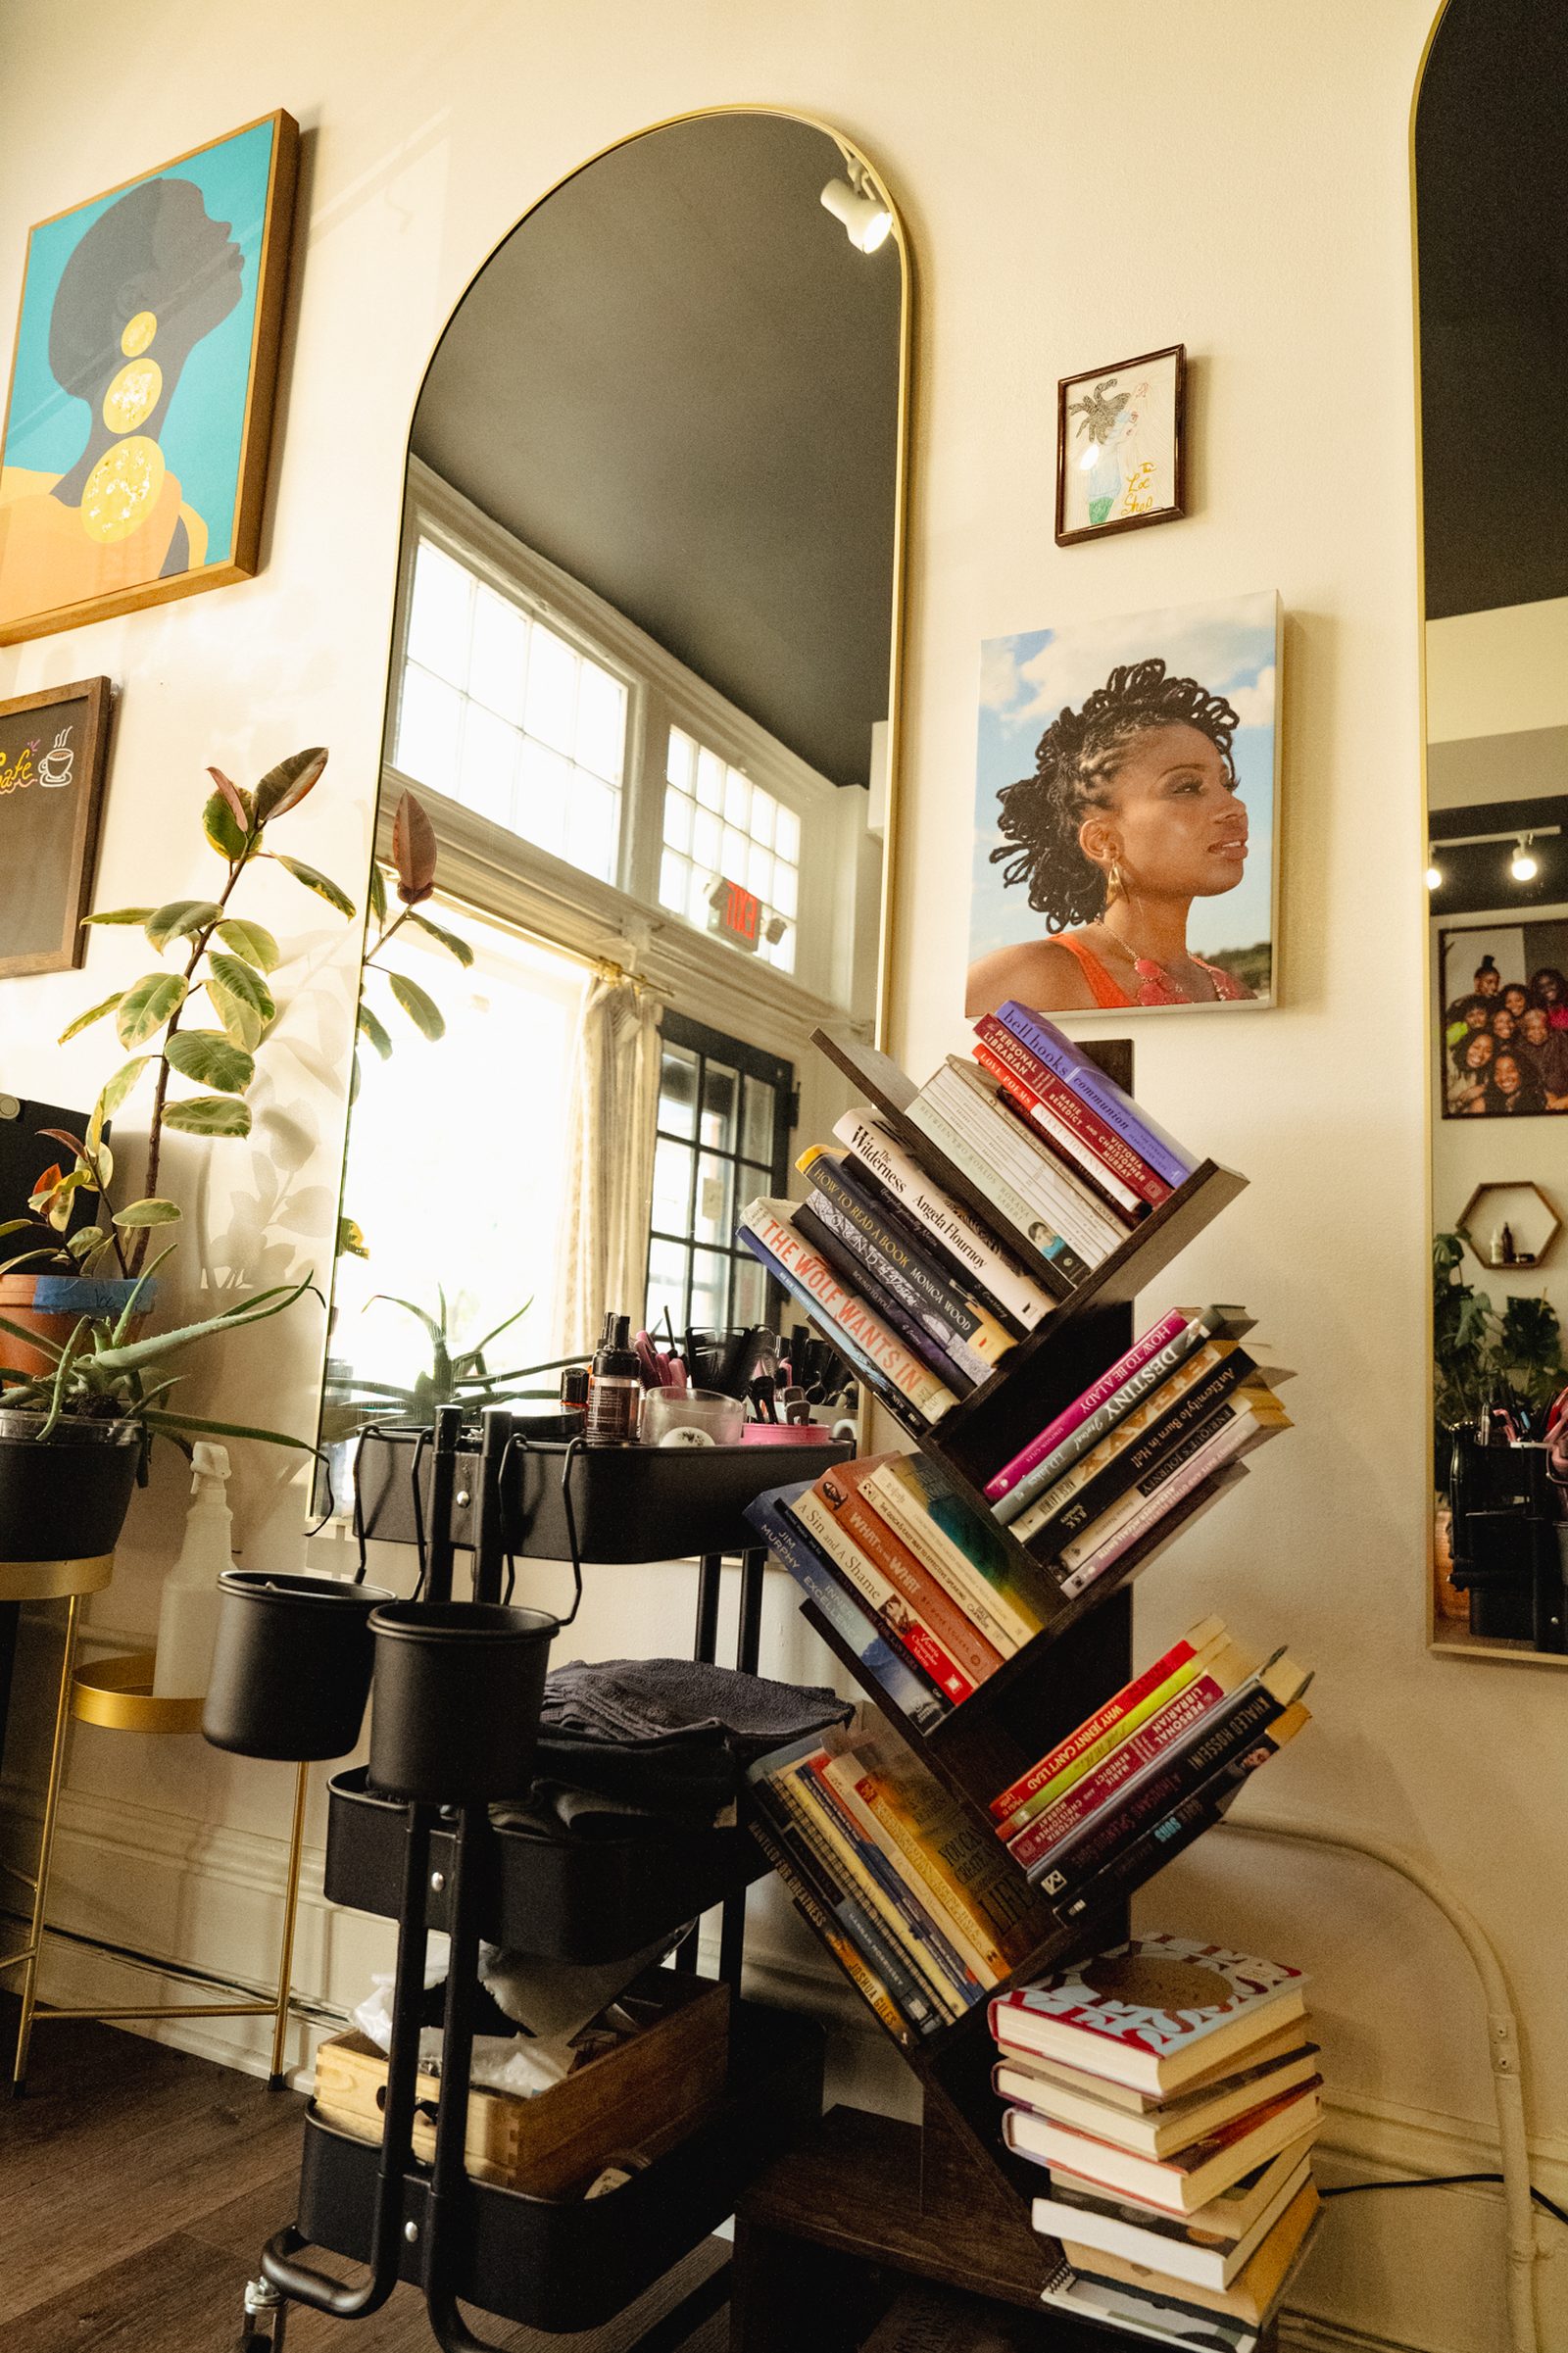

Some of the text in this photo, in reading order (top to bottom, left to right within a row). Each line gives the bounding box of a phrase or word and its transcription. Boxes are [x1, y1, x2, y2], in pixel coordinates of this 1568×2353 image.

[982, 1031, 1028, 1076] LIBRARIAN
[993, 1028, 1040, 1073] PERSONAL
[1003, 1007, 1072, 1077] bell hooks
[979, 1052, 1004, 1076] LOVE
[1003, 1074, 1032, 1104] POEMS
[1048, 1093, 1083, 1127] BENEDICT
[1058, 1092, 1082, 1116] MARIE
[1071, 1073, 1131, 1131] communion
[846, 1124, 908, 1194] Wilderness
[877, 1149, 894, 1165] The
[918, 1104, 952, 1139] BETWEEN
[951, 1137, 969, 1155] TWO
[966, 1153, 998, 1185] WORLDS
[1096, 1134, 1147, 1183] CHRISTOPHER
[1101, 1149, 1132, 1179] MURRAY
[1108, 1135, 1144, 1170] VICTORIA
[812, 1167, 911, 1269] HOW TO READ A BOOK
[999, 1187, 1030, 1217] ROXANA
[818, 1203, 880, 1266] BOUND
[909, 1191, 950, 1231] Angela
[942, 1221, 989, 1273] Flournoy
[759, 1218, 800, 1262] THE
[790, 1251, 844, 1307] WOLF
[833, 1299, 903, 1371] WANTS
[892, 1361, 924, 1395] IN
[851, 1269, 891, 1310] BOUND TO YOU
[908, 1266, 946, 1304] MONICA
[941, 1299, 972, 1332] WOOD
[1077, 1325, 1171, 1414] HOW TO BE A LADY
[1099, 1345, 1180, 1421] DESTINY
[1217, 1366, 1236, 1386] An
[1072, 1348, 1215, 1482] HEAVY
[1183, 1378, 1224, 1415] Eternity
[1139, 1407, 1232, 1494] ENRIQUE'S JOURNEY
[1147, 1436, 1161, 1451] in
[1156, 1416, 1183, 1443] Burn
[1129, 1445, 1152, 1469] Hell
[759, 1523, 801, 1570] MURPHY
[777, 1529, 797, 1549] JIM
[797, 1501, 883, 1600] A Sin and A Shame
[847, 1511, 921, 1595] WHAT WHAT
[824, 1585, 856, 1620] INNER
[1098, 1701, 1124, 1727] WHY
[1150, 1686, 1202, 1734] LIBRARIAN
[1152, 1699, 1204, 1746] PERSONAL
[1185, 1693, 1271, 1772] KHALED HOSSEINI
[1072, 1719, 1103, 1750] JENNY
[1024, 1766, 1052, 1791] LEAD
[1047, 1743, 1077, 1773] CAN'T
[1092, 1750, 1130, 1786] BENEDICT
[1103, 1762, 1130, 1787] MARIE
[1032, 1797, 1084, 1843] CHRISTOPHER
[1037, 1800, 1067, 1829] MURRAY
[1045, 1809, 1082, 1843] VICTORIA
[746, 1819, 781, 1862] MANTLED
[773, 1857, 794, 1880] FOR
[786, 1875, 828, 1928] GREATNESS
[847, 1912, 873, 1945] HANNAH
[847, 1962, 898, 2027] JOSHUA GILES
